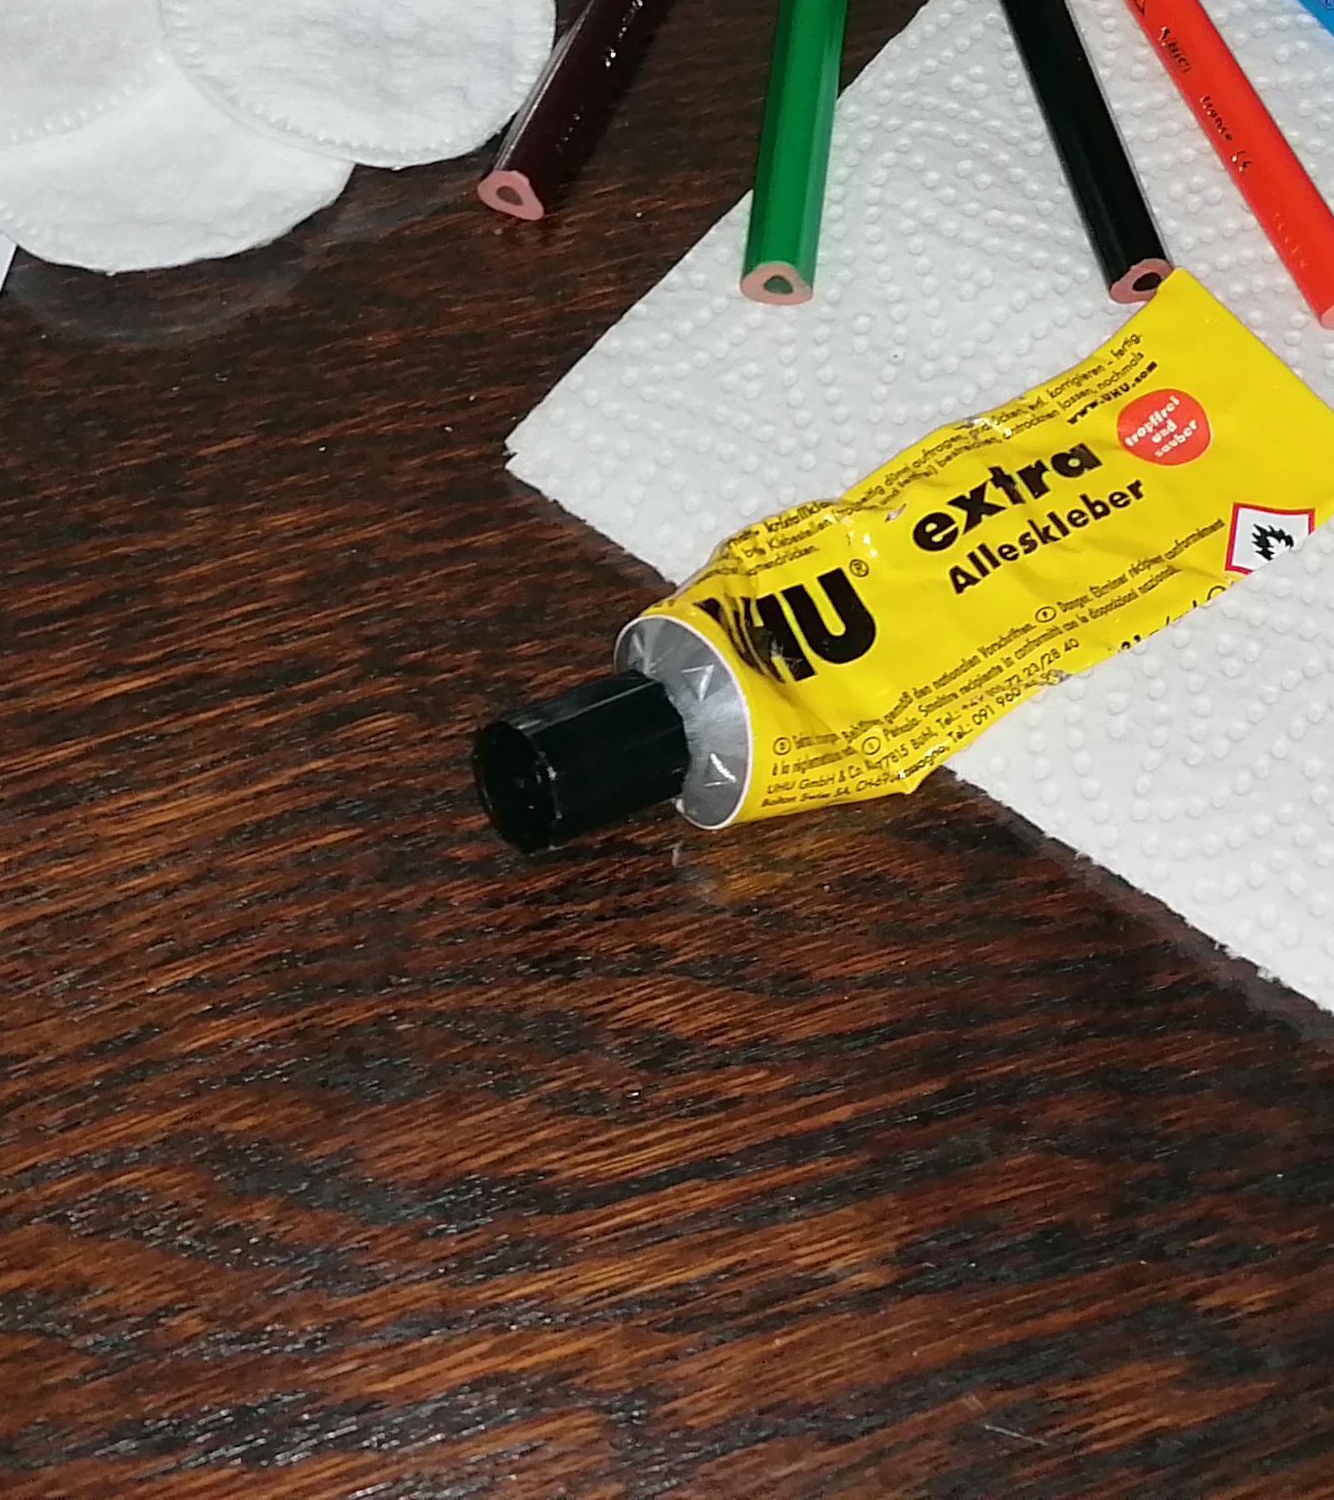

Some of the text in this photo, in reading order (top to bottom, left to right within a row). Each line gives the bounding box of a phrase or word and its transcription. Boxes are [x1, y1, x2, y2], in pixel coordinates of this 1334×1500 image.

[1066, 360, 1159, 426] www.UHU.com
[1096, 351, 1145, 392] nochmals
[911, 432, 969, 469] auftragen,
[1046, 363, 1107, 399] korrigieren
[1110, 332, 1143, 360] fertig.
[1124, 394, 1180, 447] tropffrei
[1151, 418, 1178, 443] und
[1154, 419, 1198, 458] sauber
[913, 442, 1103, 553] extra
[948, 478, 1146, 595] Alleskleber
[970, 704, 996, 727] 091
[995, 687, 1022, 708] 960
